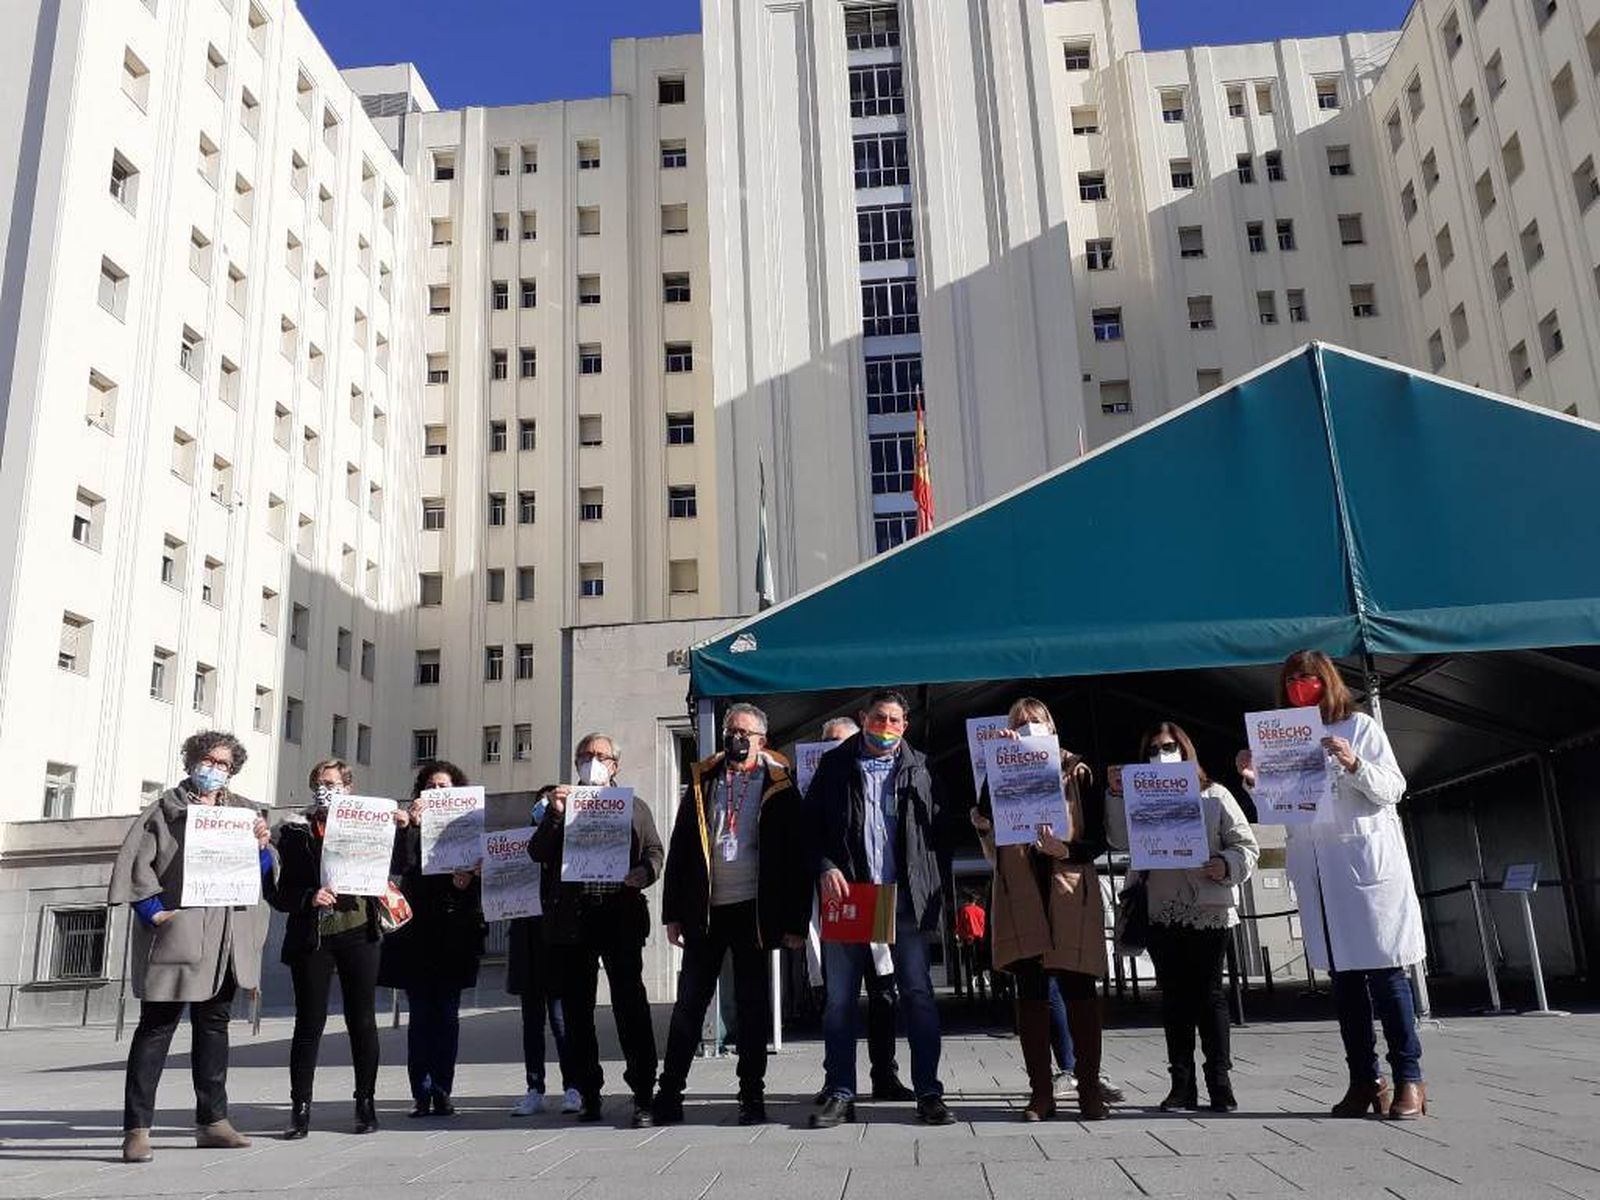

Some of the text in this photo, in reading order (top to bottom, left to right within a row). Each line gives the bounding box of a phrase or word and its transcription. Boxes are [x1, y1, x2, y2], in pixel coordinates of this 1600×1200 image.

[1258, 726, 1312, 740] DERECHO
[996, 751, 1049, 765] DERECHO
[1134, 778, 1188, 789] DERECHO
[429, 797, 477, 809] DERECHO
[574, 800, 625, 811] DERECHO
[336, 809, 390, 823] DERECHO
[194, 818, 252, 830] DERECHO
[487, 840, 529, 856] DERECH
